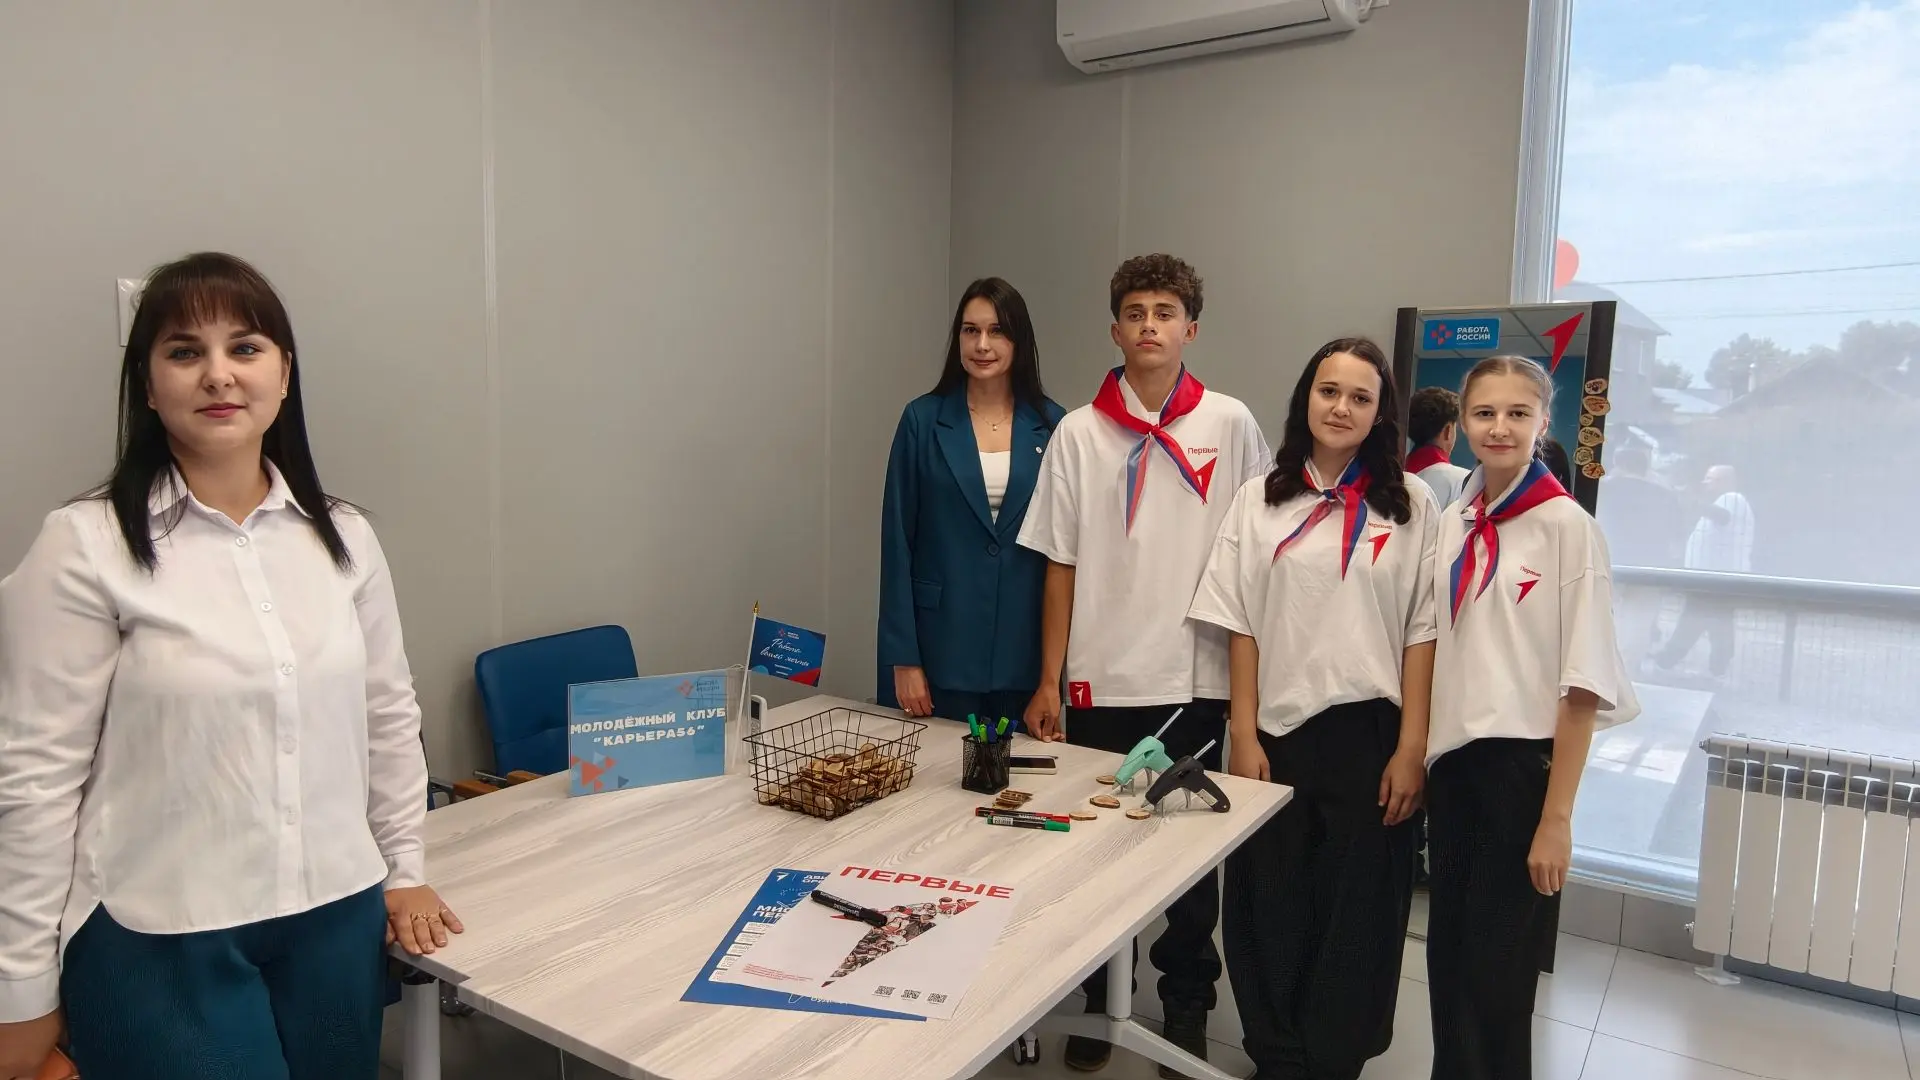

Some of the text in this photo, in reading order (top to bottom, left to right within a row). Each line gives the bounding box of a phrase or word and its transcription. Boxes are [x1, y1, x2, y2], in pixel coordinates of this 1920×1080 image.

[1456, 333, 1491, 341] РОССИИ
[1187, 447, 1218, 455] Первые
[570, 707, 726, 734] МОЛОДЁЖНЫЙ КЛУБ
[839, 866, 1015, 899] ПЕРВЫЕ
